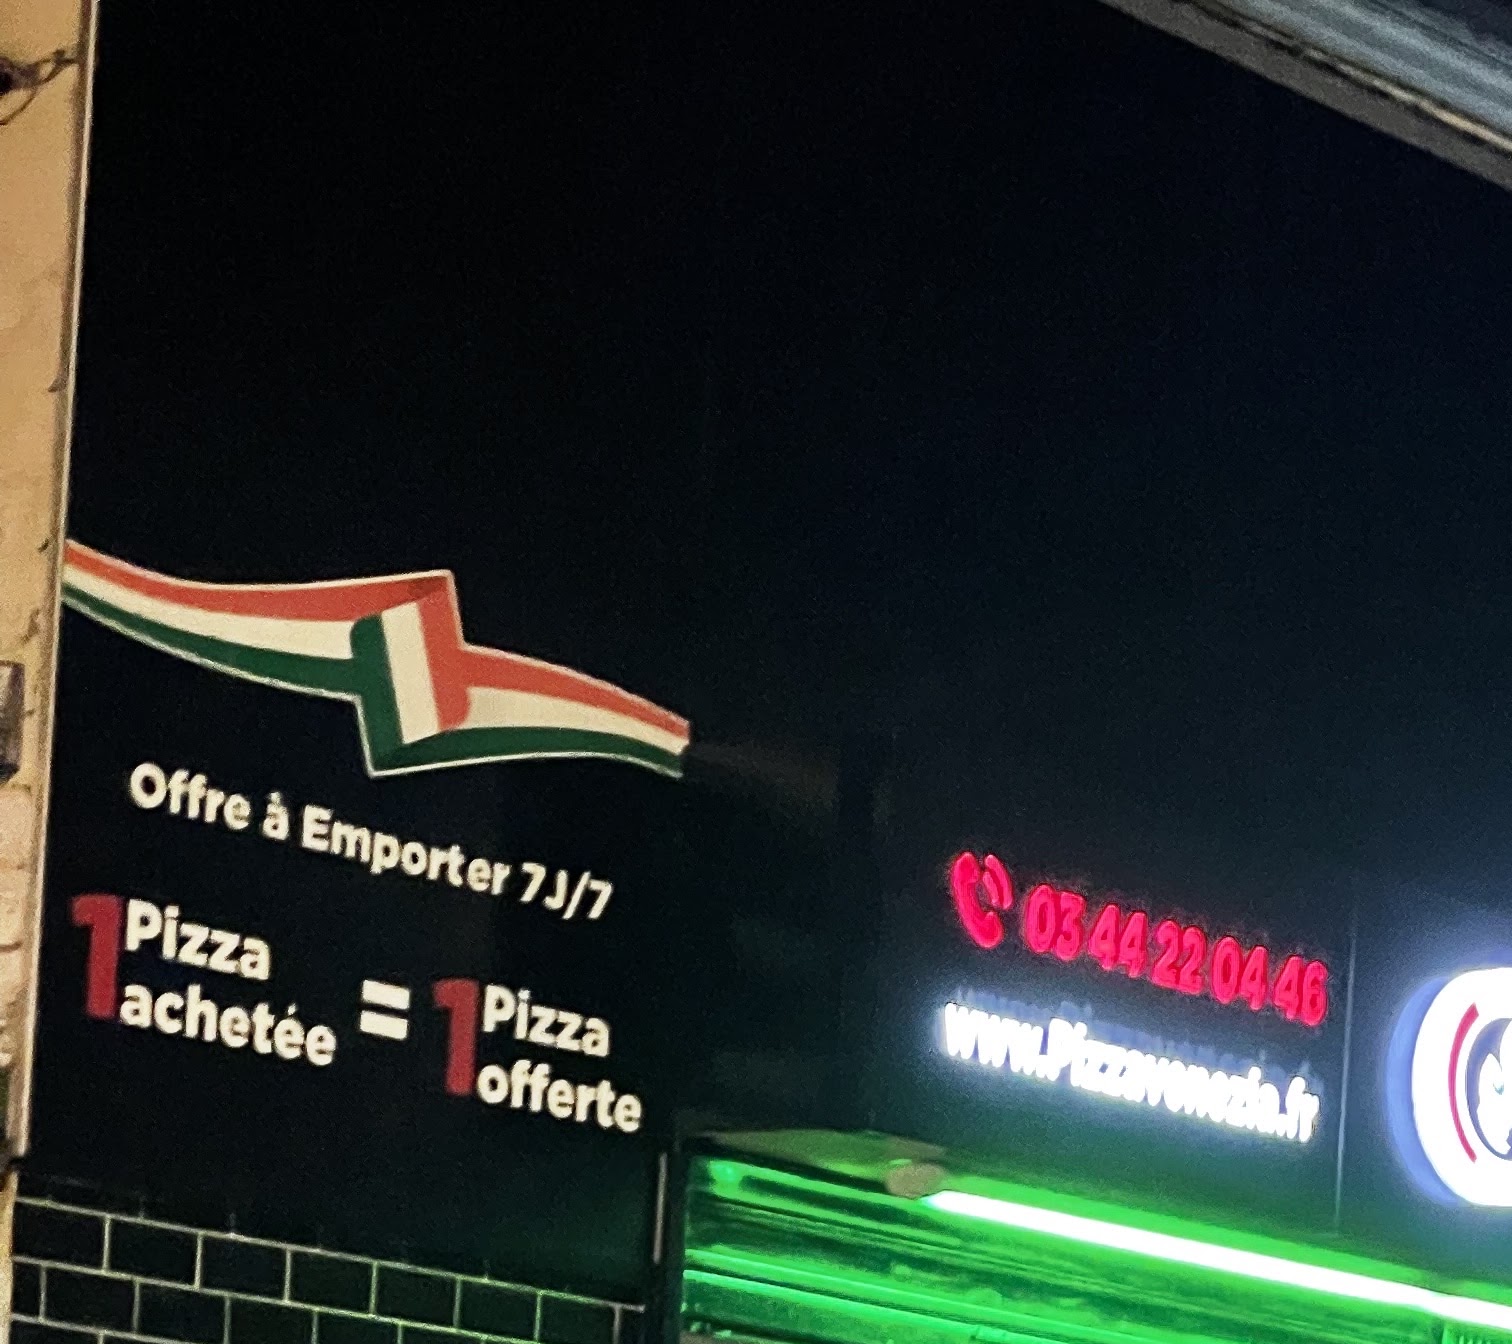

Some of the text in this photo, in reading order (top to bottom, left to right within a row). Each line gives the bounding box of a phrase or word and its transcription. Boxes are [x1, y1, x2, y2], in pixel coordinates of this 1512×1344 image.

[130, 762, 250, 831] Offre
[263, 793, 291, 840] à
[301, 807, 510, 896] Emporter
[71, 894, 271, 1020] 1 Pizza
[1024, 884, 1328, 1026] 03 44 22 04 46
[119, 983, 337, 1065] achetée
[432, 978, 611, 1095] 1 Pizza
[477, 1060, 643, 1133] offerte
